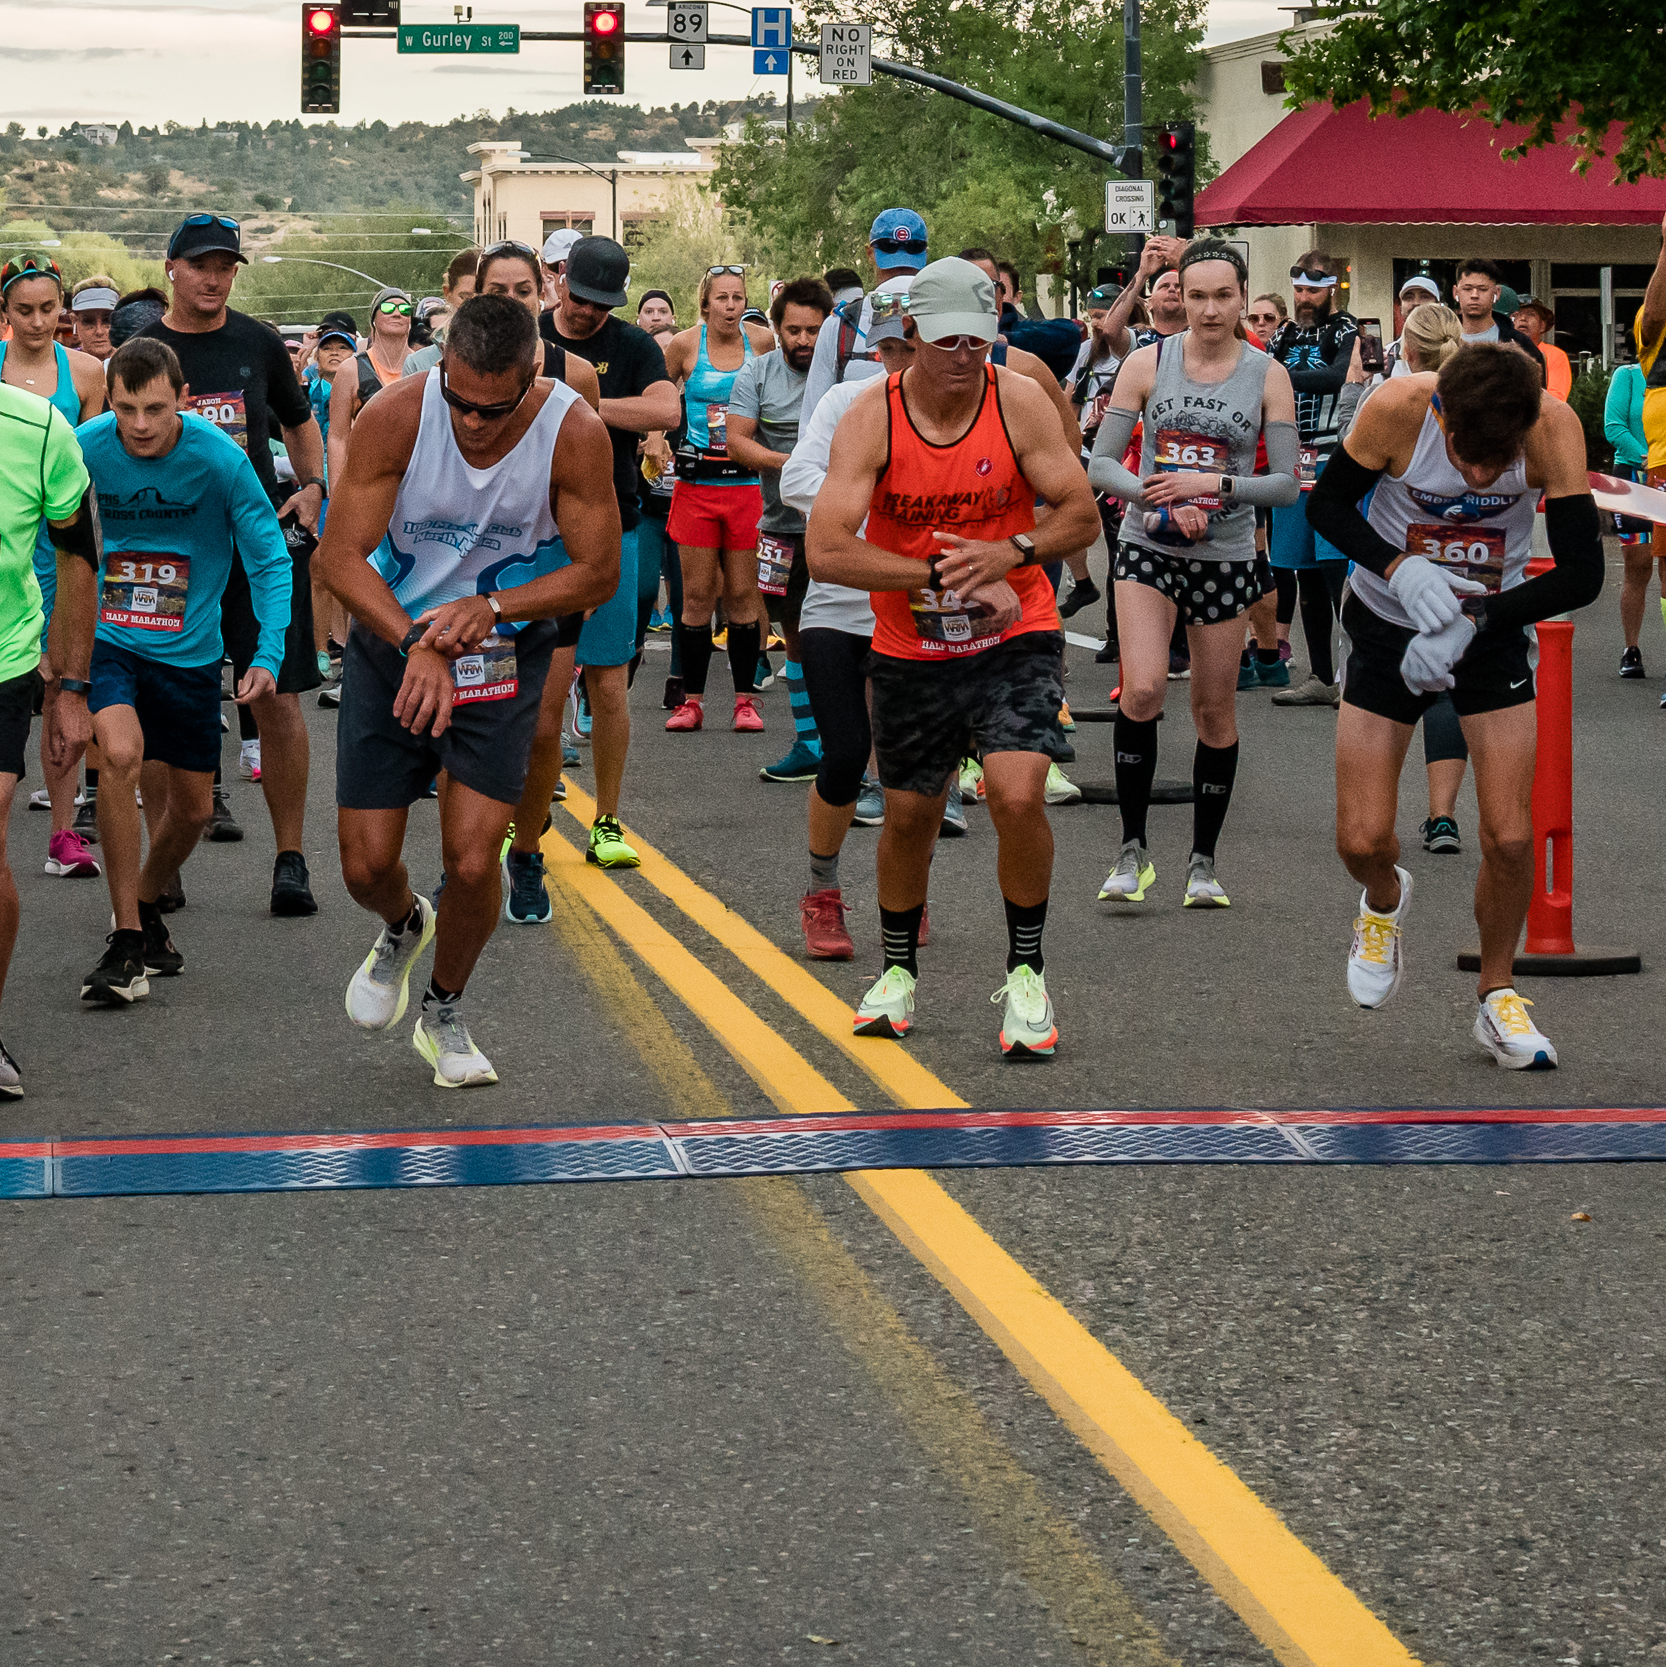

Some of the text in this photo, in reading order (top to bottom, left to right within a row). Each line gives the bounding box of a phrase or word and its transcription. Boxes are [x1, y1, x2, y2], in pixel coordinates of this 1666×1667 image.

[673, 13, 703, 33] 89
[757, 10, 787, 45] H
[405, 36, 413, 46] W
[422, 31, 472, 51] Gurley
[481, 36, 492, 46] St
[832, 28, 860, 42] NO
[826, 45, 865, 55] RIGHT
[836, 57, 855, 67] ON
[833, 69, 858, 80] RED
[1114, 185, 1144, 193] DIAGONAL
[1111, 213, 1127, 225] OK
[1151, 396, 1251, 433] GET FAST OR
[1165, 442, 1215, 466] 363
[97, 493, 120, 505] PHS
[139, 506, 198, 521] COUNTRY
[1422, 538, 1490, 564] 360
[118, 561, 176, 585] 319
[106, 611, 181, 627] HALF MARATHON
[921, 635, 1001, 654] HALF MARATHON
[459, 683, 515, 700] MARATHON
